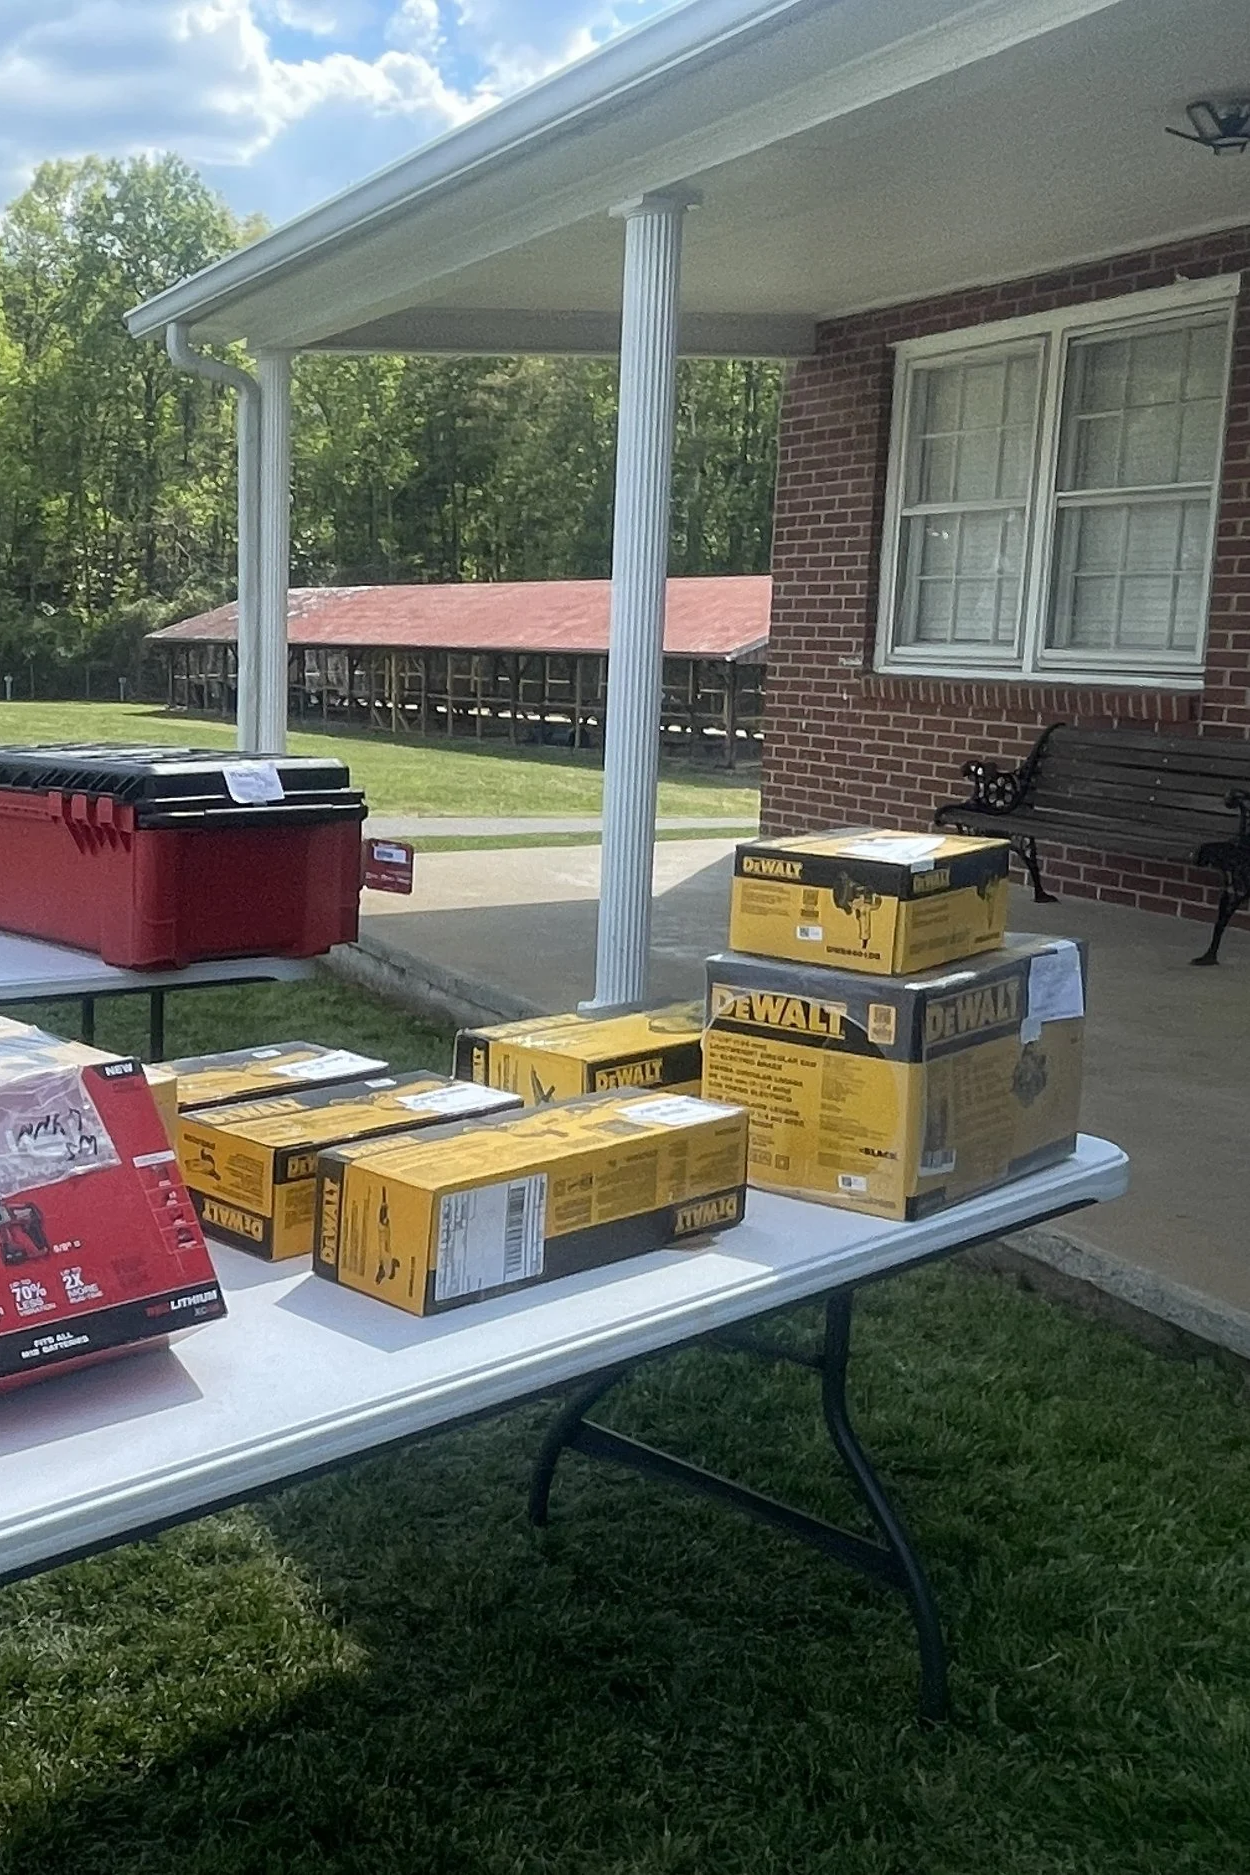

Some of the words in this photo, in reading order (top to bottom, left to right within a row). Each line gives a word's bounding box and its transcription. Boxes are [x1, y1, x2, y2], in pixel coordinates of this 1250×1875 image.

[742, 856, 803, 878] DEWALT
[712, 987, 846, 1037] DEWALT
[925, 979, 1020, 1043] DEWALT
[105, 1063, 133, 1077] NEW
[596, 1058, 663, 1092] DEWALT
[202, 1198, 263, 1242] DEWALT
[319, 1176, 341, 1265] DEWALT
[674, 1192, 737, 1235] DEWALT
[11, 1281, 48, 1301] 70%
[62, 1272, 85, 1290] 2X
[67, 1283, 100, 1298] MORE
[15, 1298, 45, 1311] LESS
[33, 1336, 55, 1348] FITS
[55, 1331, 75, 1344] ALL
